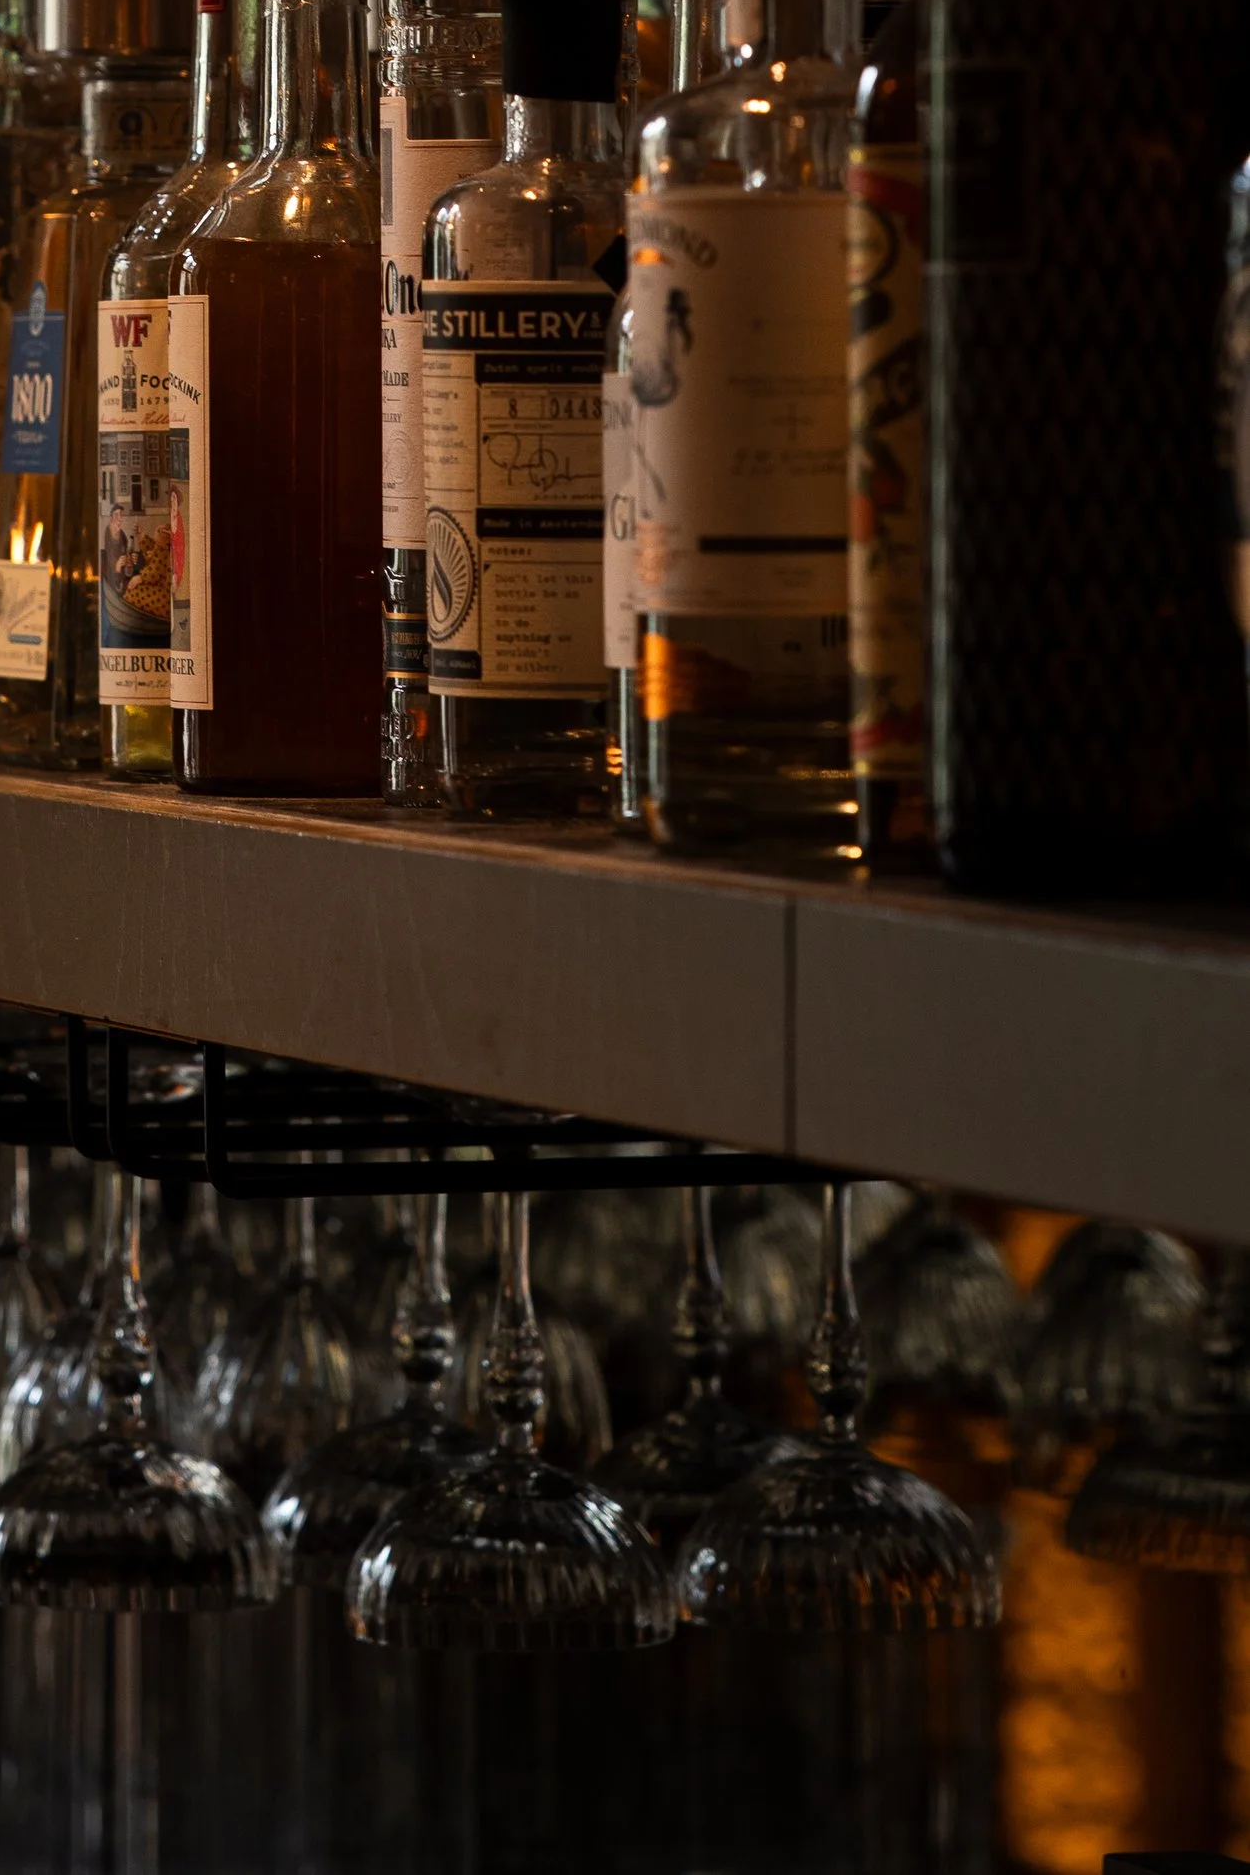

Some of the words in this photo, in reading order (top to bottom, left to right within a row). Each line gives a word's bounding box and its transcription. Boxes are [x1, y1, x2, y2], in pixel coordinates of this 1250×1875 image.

[442, 310, 587, 339] STILLERY
[111, 313, 152, 348] WF
[508, 398, 518, 420] 8
[488, 547, 532, 555] notes:
[537, 574, 557, 584] let
[565, 575, 594, 584] this
[543, 589, 558, 598] be
[514, 618, 530, 627] do
[495, 632, 551, 644] anything
